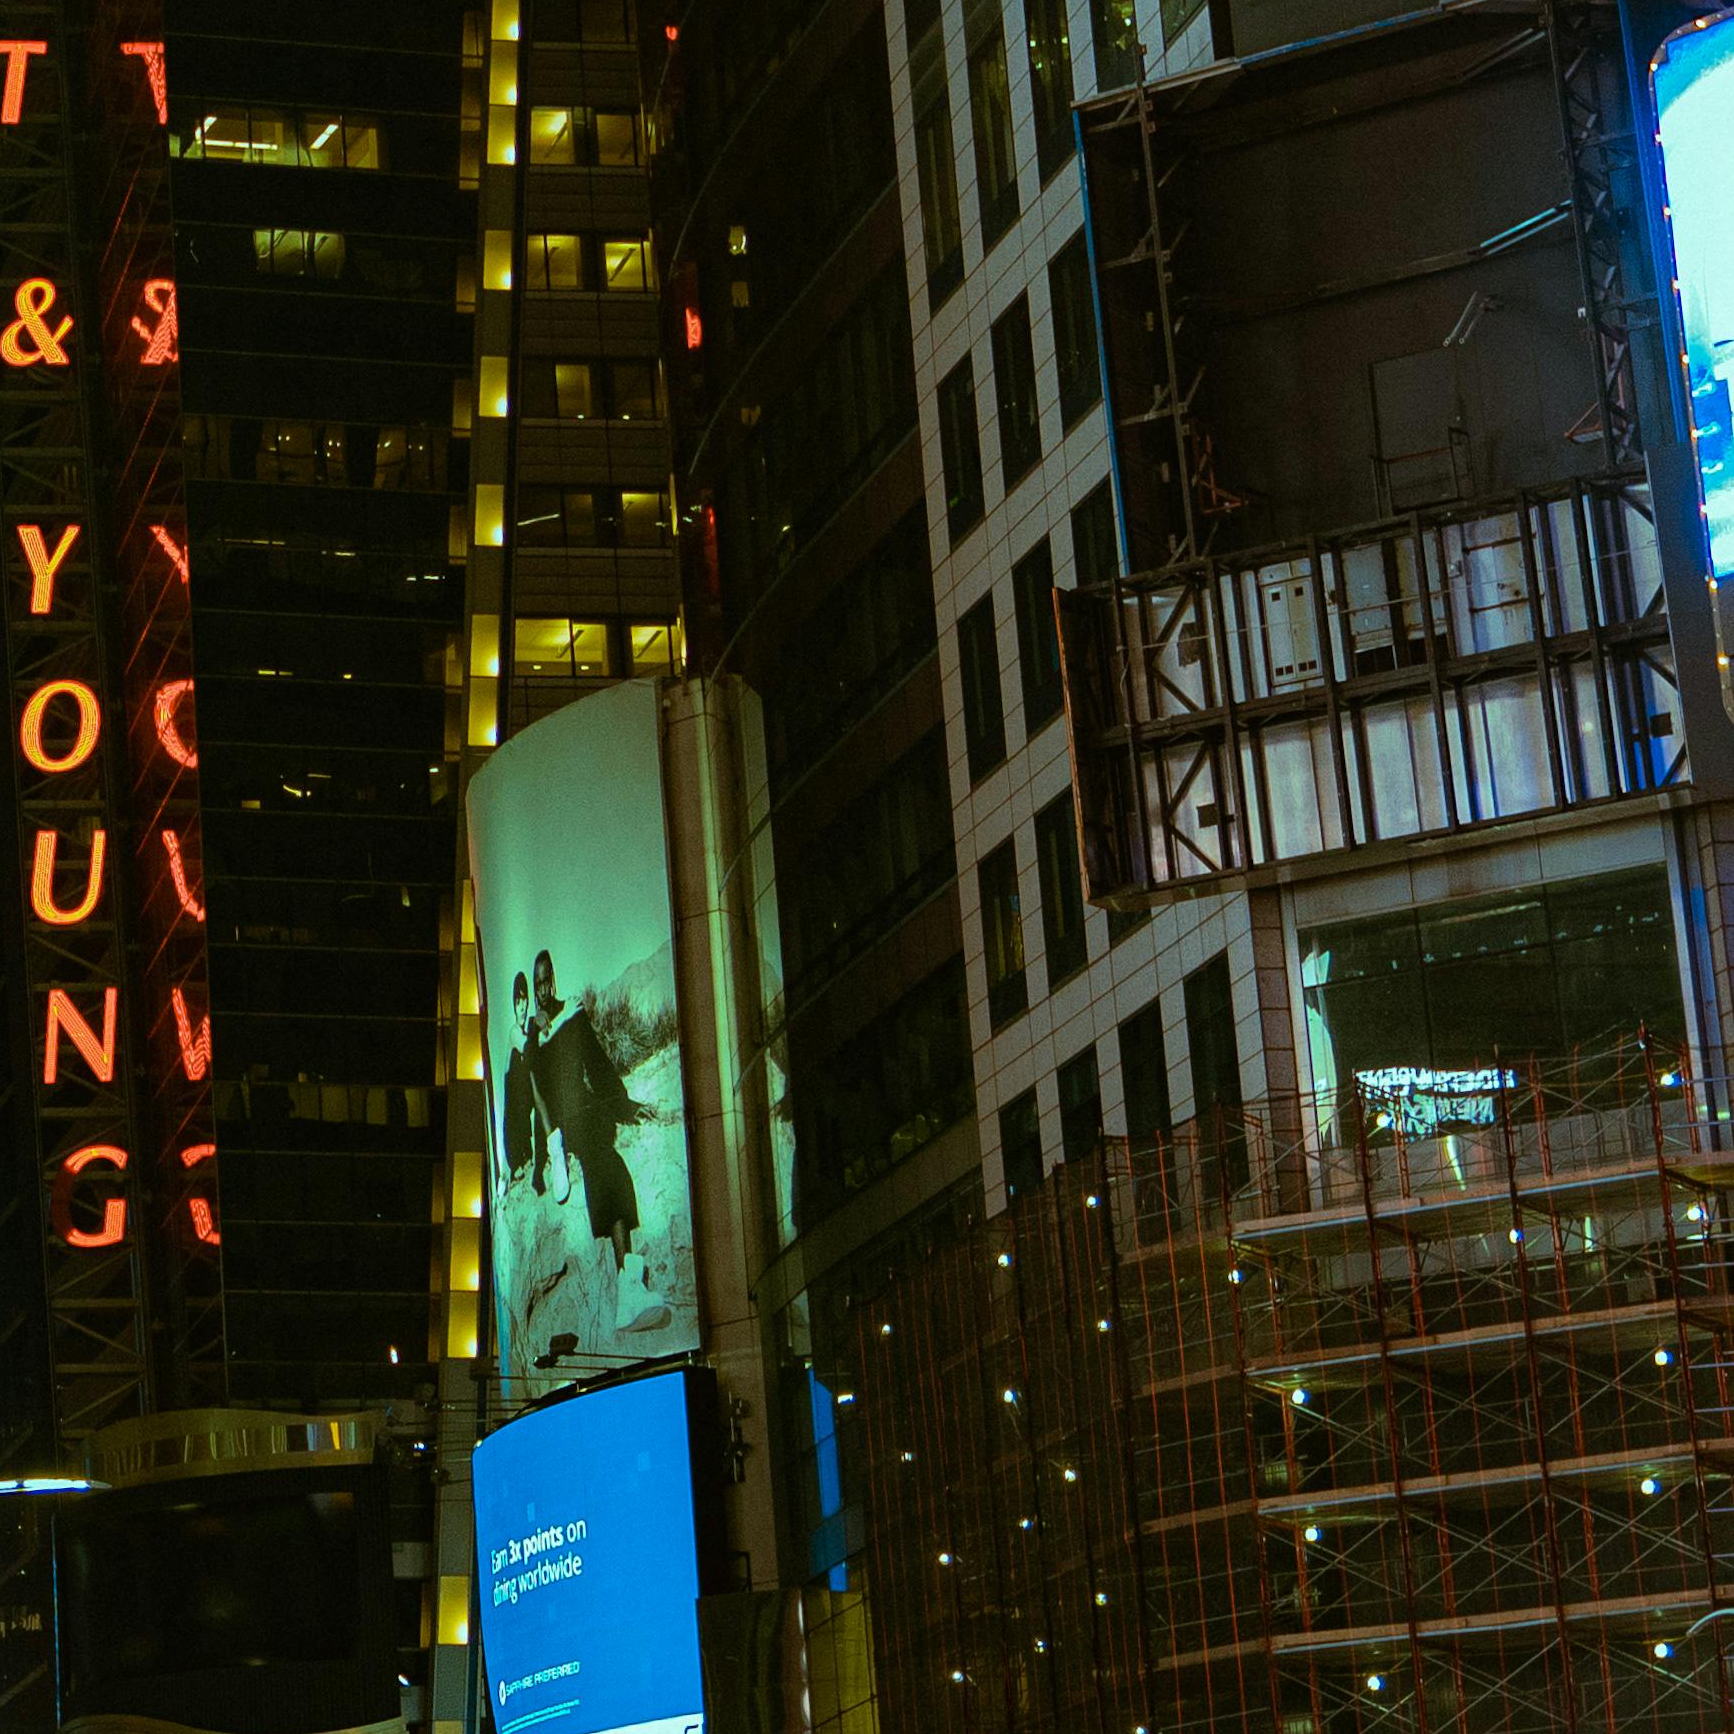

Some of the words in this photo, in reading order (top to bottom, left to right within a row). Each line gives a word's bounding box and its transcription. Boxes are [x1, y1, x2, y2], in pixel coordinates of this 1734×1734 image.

[16, 524, 132, 1249] YOUNG
[491, 1547, 509, 1575] Earn
[508, 1537, 523, 1564] 3x
[522, 1524, 564, 1558] points
[566, 1518, 587, 1545] on
[492, 1573, 518, 1608] dining
[518, 1551, 583, 1591] worldwide
[534, 1661, 581, 1687] PREFERRED
